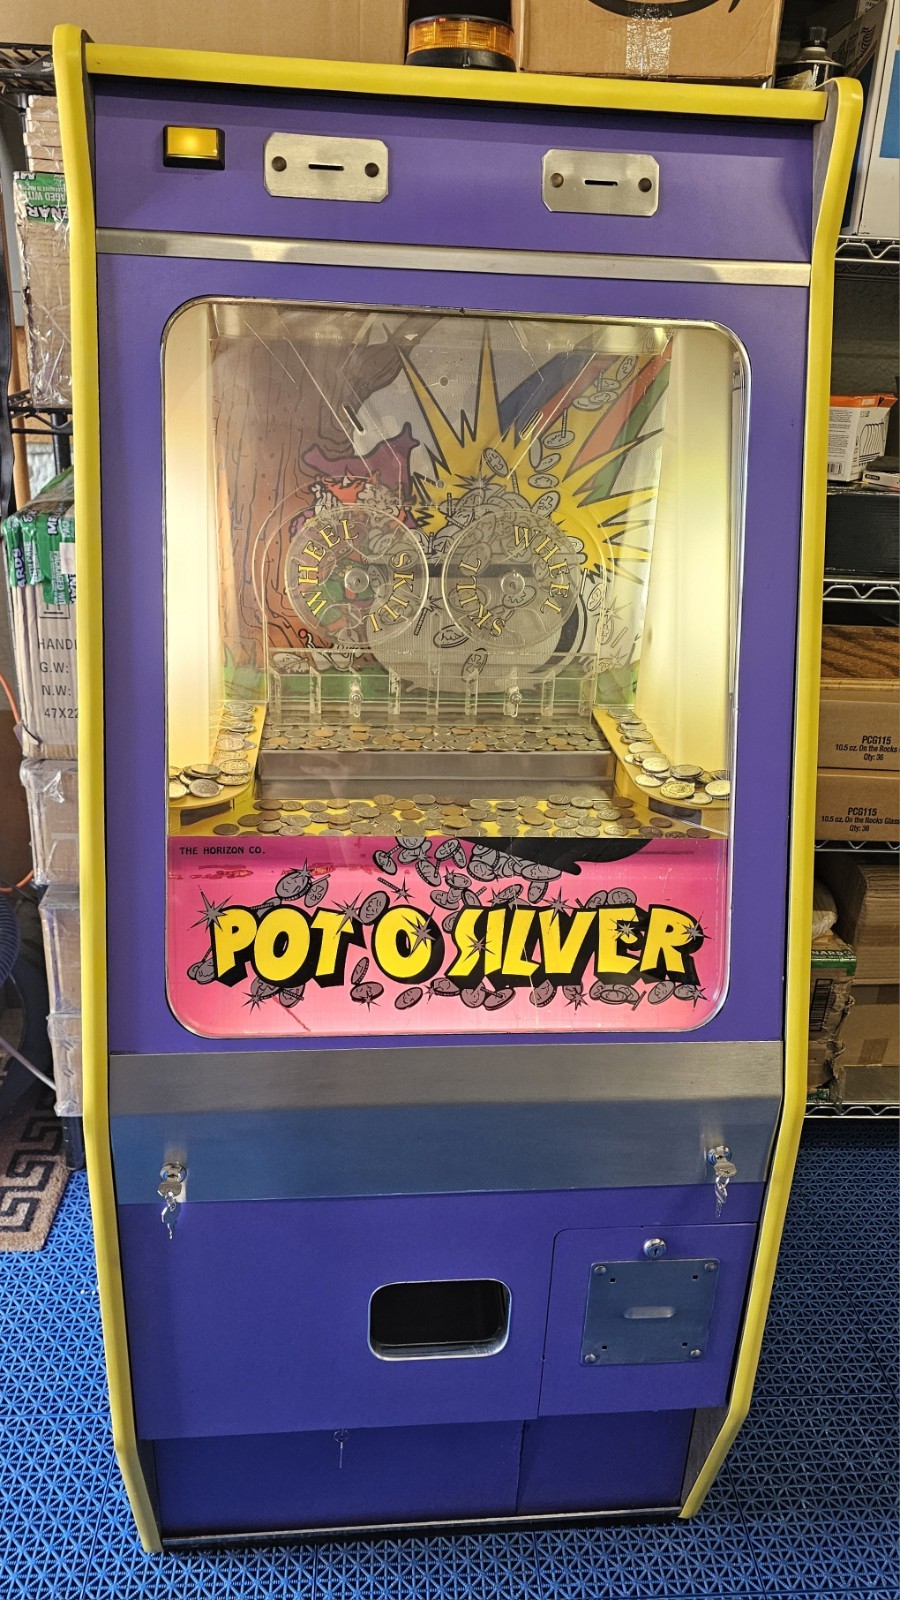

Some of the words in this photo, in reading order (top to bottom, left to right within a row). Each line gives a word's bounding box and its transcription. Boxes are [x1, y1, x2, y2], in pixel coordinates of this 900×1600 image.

[298, 519, 360, 617] WHEEL
[513, 524, 570, 615] WHEEL
[363, 551, 415, 633] SKILL
[455, 557, 506, 637] SKILL
[39, 661, 69, 674] G.W:
[41, 684, 72, 697] N.W:
[861, 735, 891, 745] PCG115
[859, 744, 868, 752] On
[869, 744, 879, 752] the
[879, 745, 898, 753] Rocks
[863, 753, 876, 761] Qty:
[847, 807, 878, 816] PCG115
[849, 825, 861, 833] Qty:
[179, 847, 198, 855] THE
[203, 846, 245, 855] HORIZON
[248, 846, 266, 854] CO.
[212, 904, 364, 988] POT
[445, 904, 703, 989] SILVER
